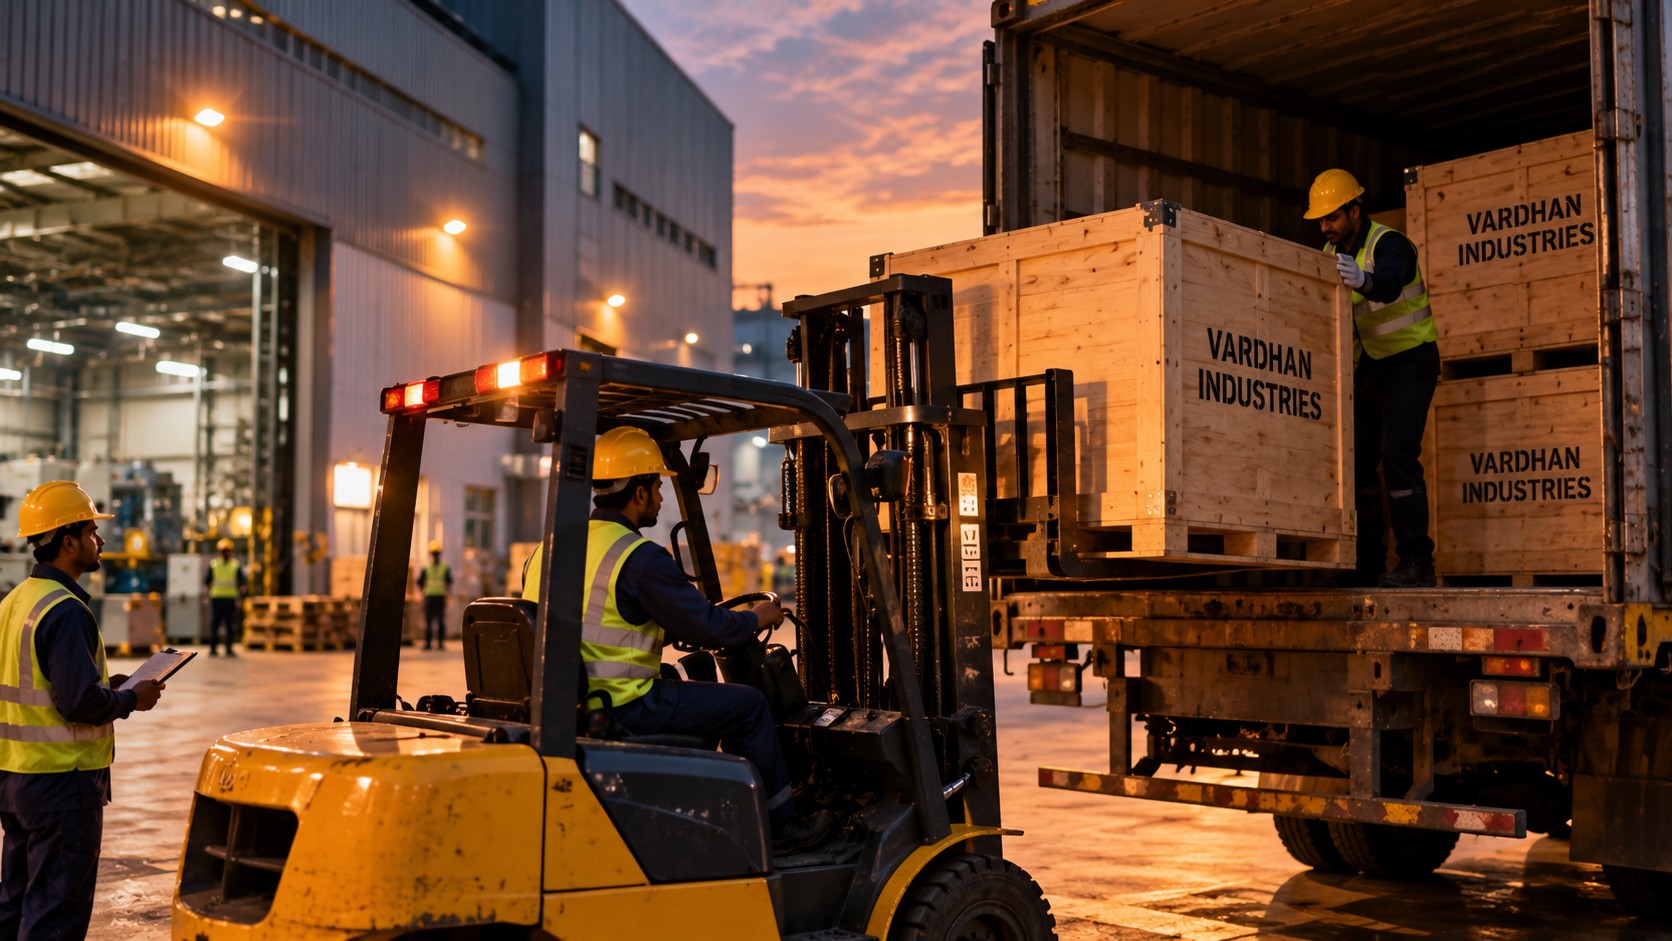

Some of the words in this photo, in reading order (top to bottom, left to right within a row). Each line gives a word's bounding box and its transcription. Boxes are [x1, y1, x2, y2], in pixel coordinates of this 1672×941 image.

[1466, 193, 1582, 235] VARDHAN
[1458, 221, 1595, 267] INDUSTRIES
[1206, 327, 1312, 381] VARDHAN
[1198, 368, 1322, 421] INDUSTRIES
[1469, 446, 1581, 475] VARDHAN
[1462, 475, 1592, 505] INDUSTRIES
